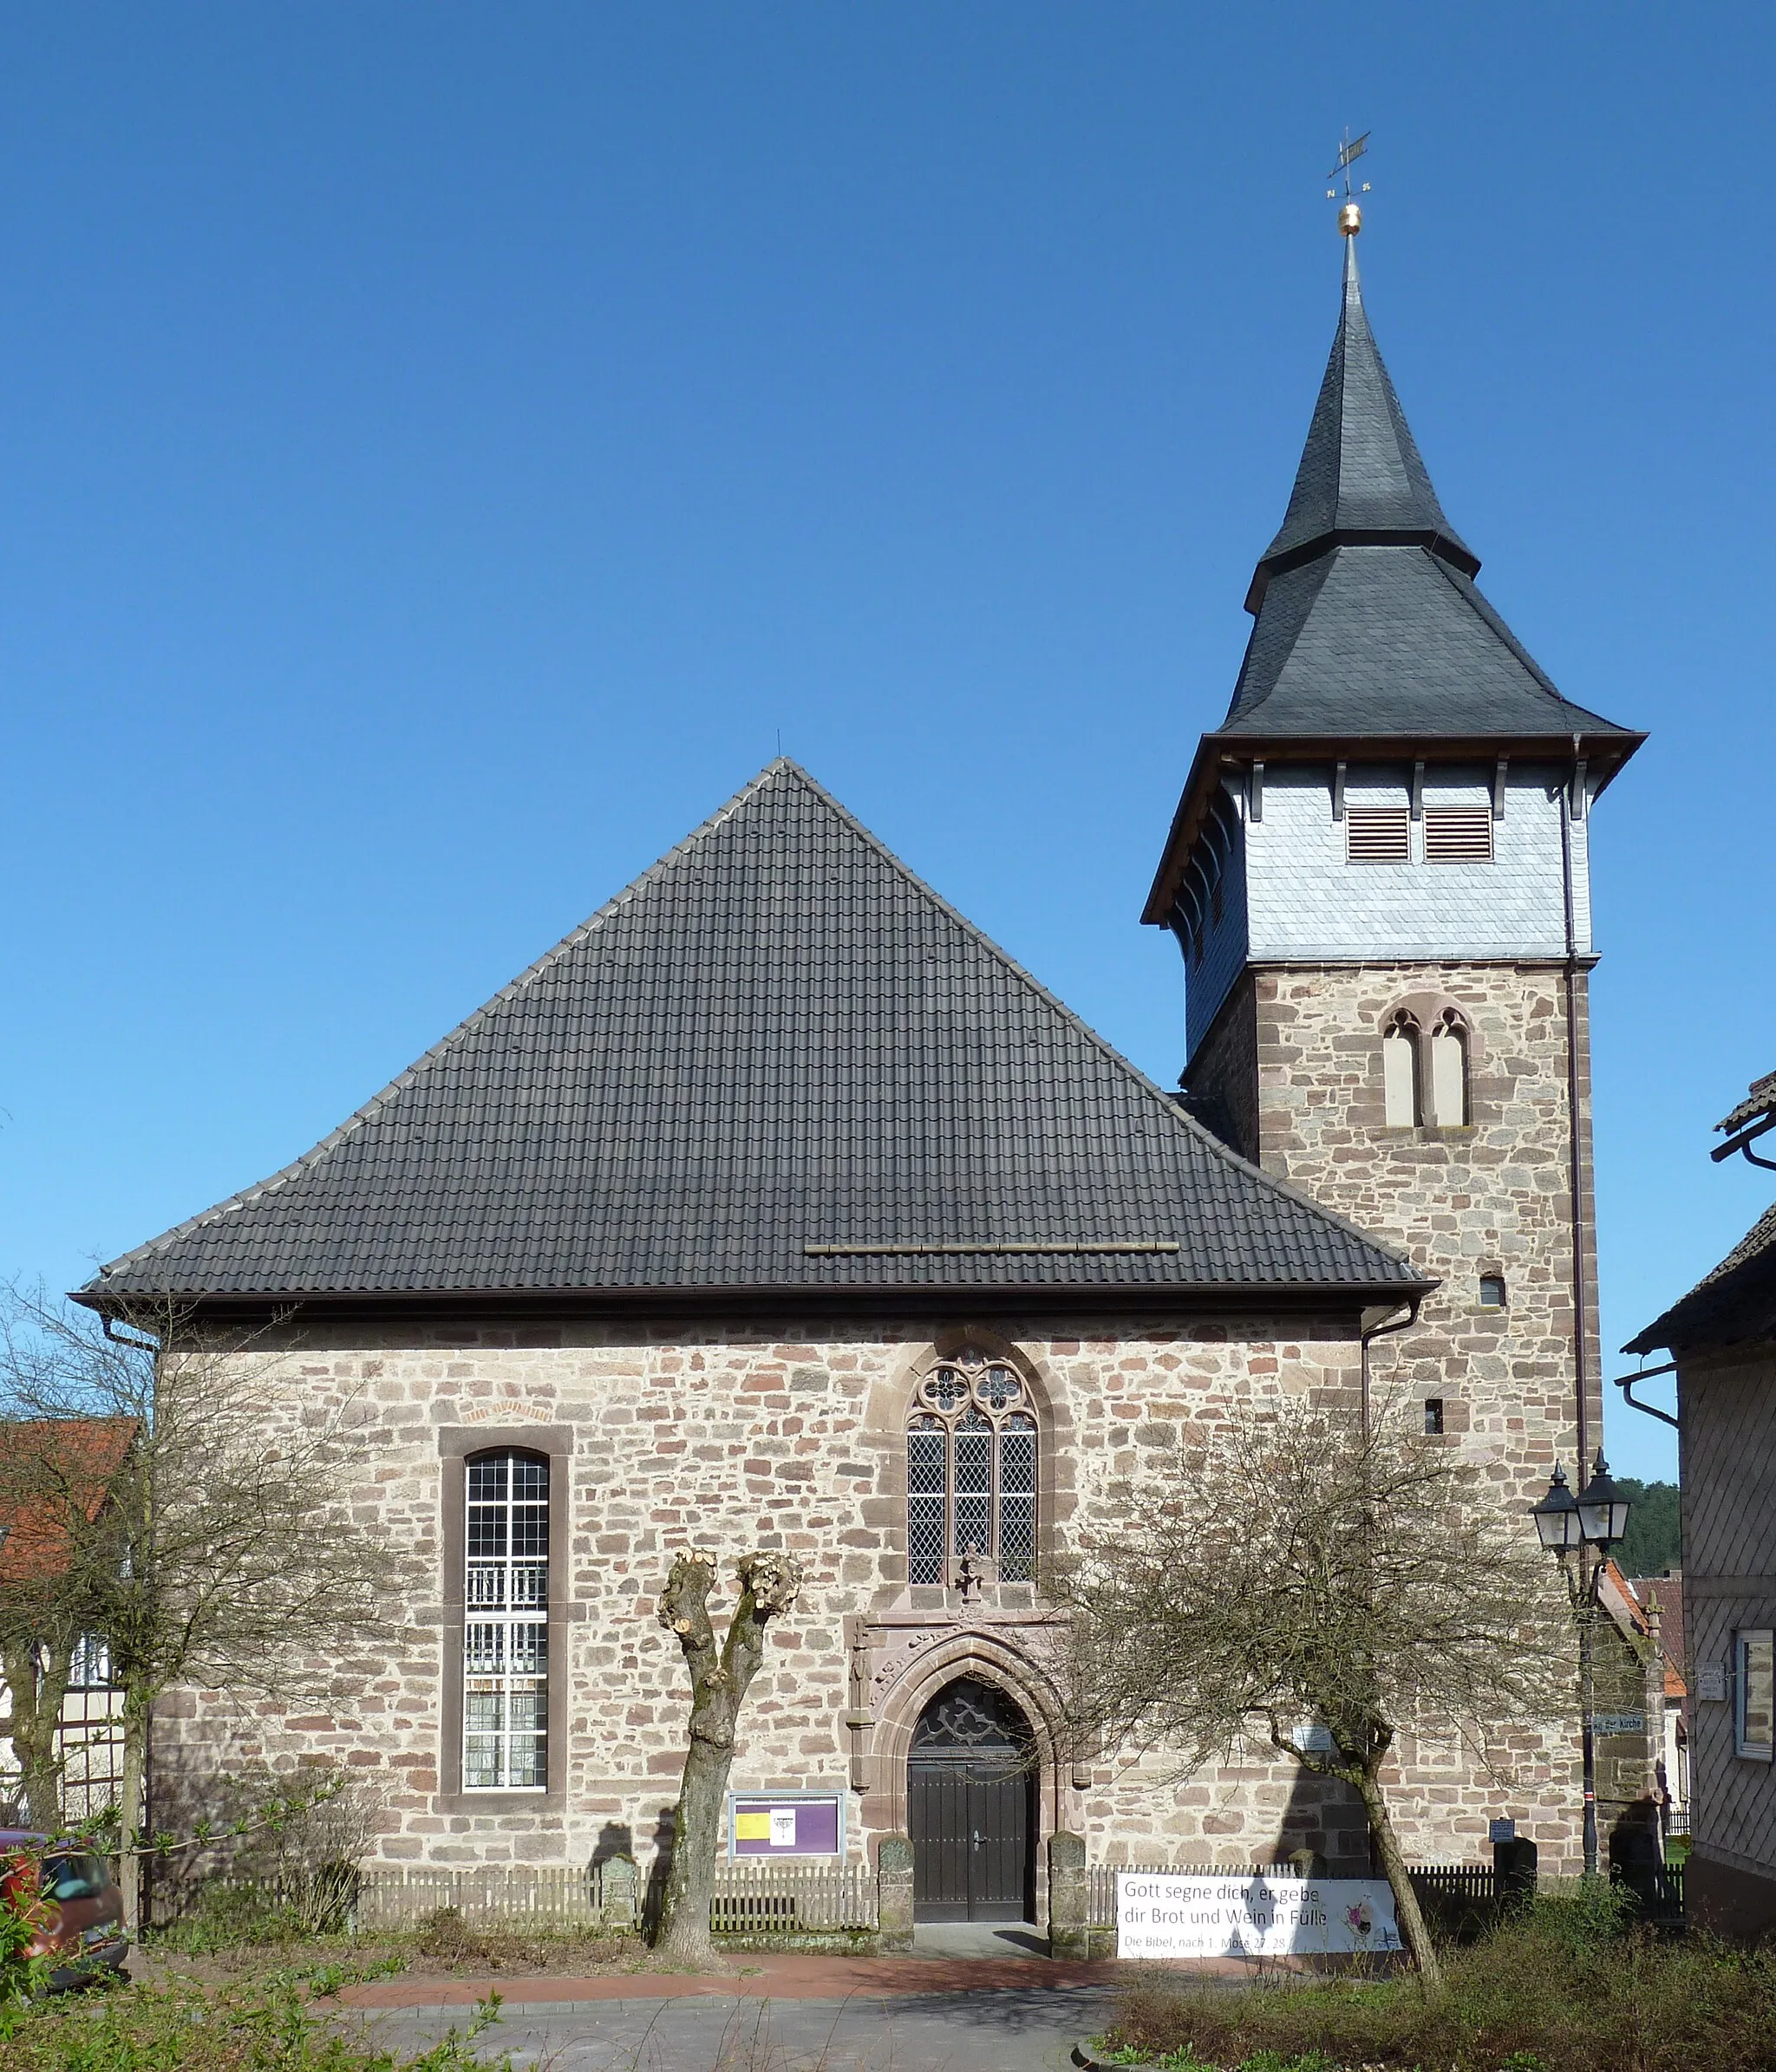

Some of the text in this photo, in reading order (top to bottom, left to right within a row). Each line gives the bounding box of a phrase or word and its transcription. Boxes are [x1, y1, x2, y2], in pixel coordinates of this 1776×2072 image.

[1619, 1717, 1641, 1729] Kirche
[1125, 1881, 1319, 1905] Gott segne dich, er gebe
[1125, 1906, 1327, 1925] dir Brot und Wein in Fülle
[1125, 1936, 1142, 1947] Die
[1146, 1936, 1175, 1950] Bibel,
[1179, 1937, 1204, 1948] nach
[1209, 1938, 1218, 1949] 1.
[1221, 1938, 1250, 1949] Mose
